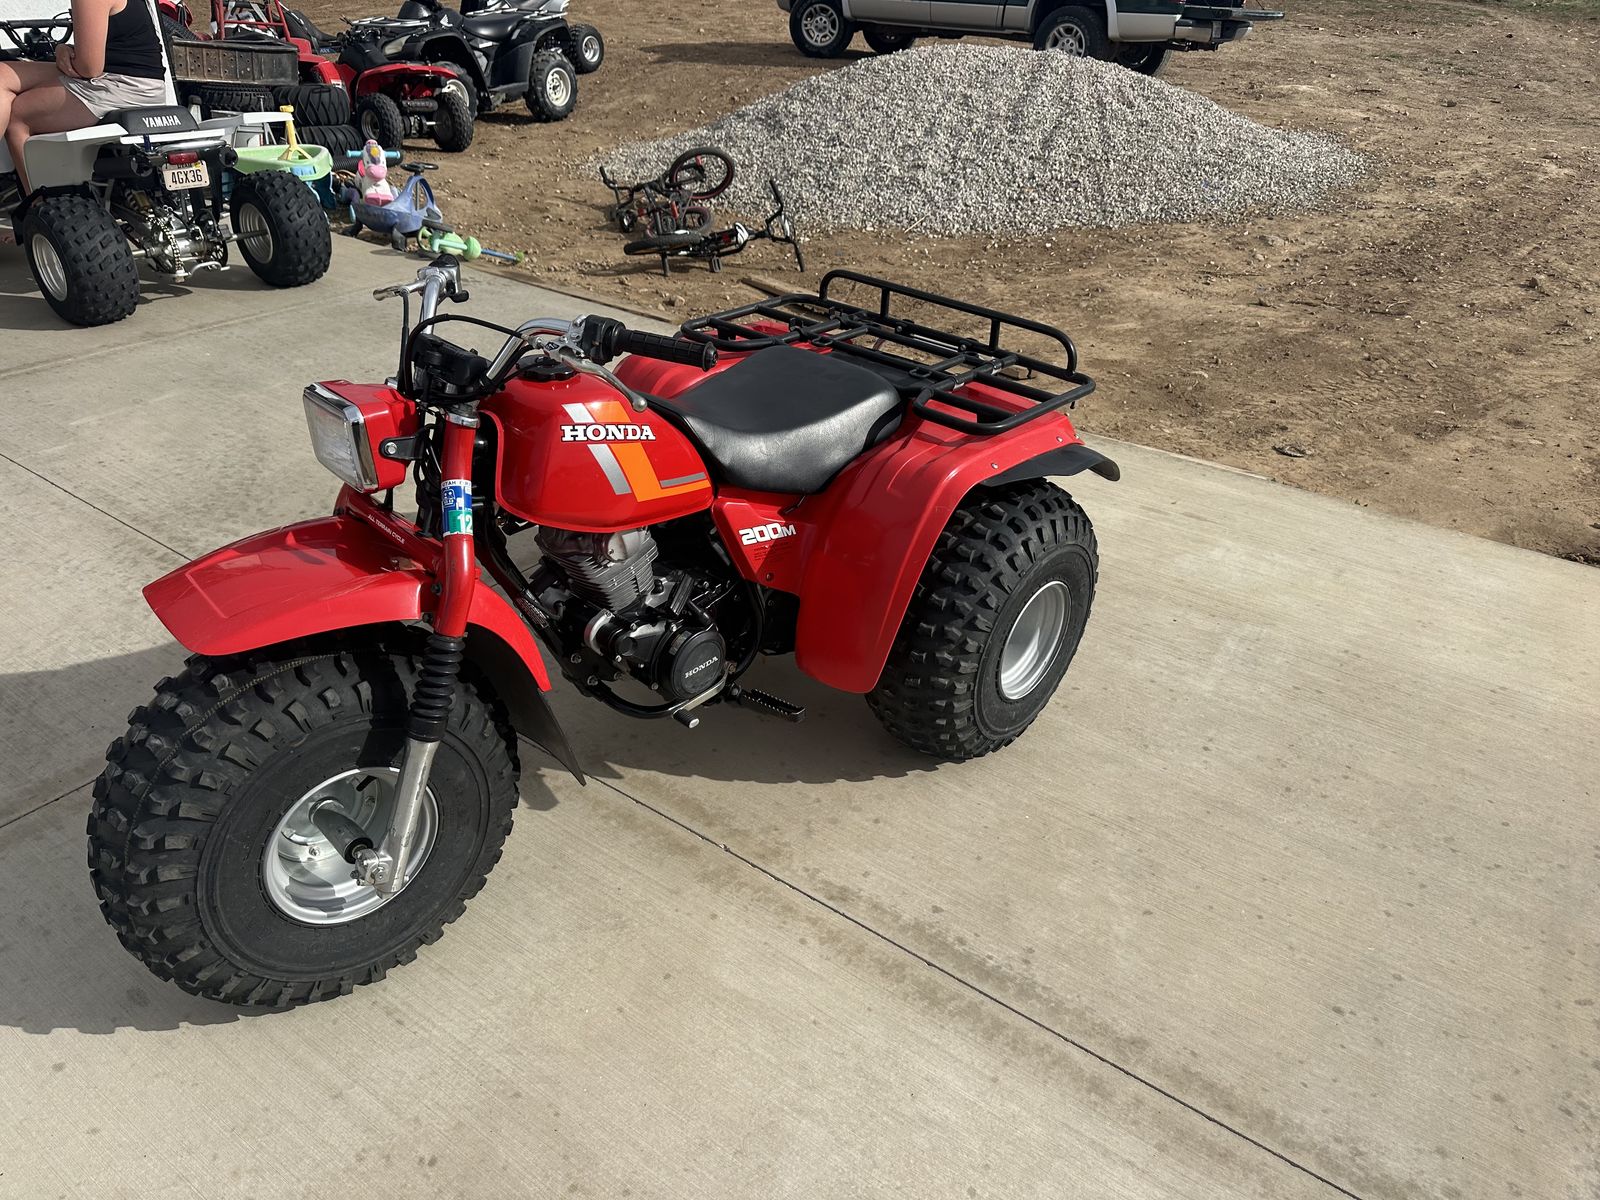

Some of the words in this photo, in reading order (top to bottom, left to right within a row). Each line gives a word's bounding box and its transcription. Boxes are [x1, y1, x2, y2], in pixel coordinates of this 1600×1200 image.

[142, 115, 181, 128] YAMAHA
[171, 169, 203, 185] 4GX36
[560, 423, 656, 442] HONDA
[391, 531, 406, 545] CYCLE
[684, 656, 719, 679] HONDA
